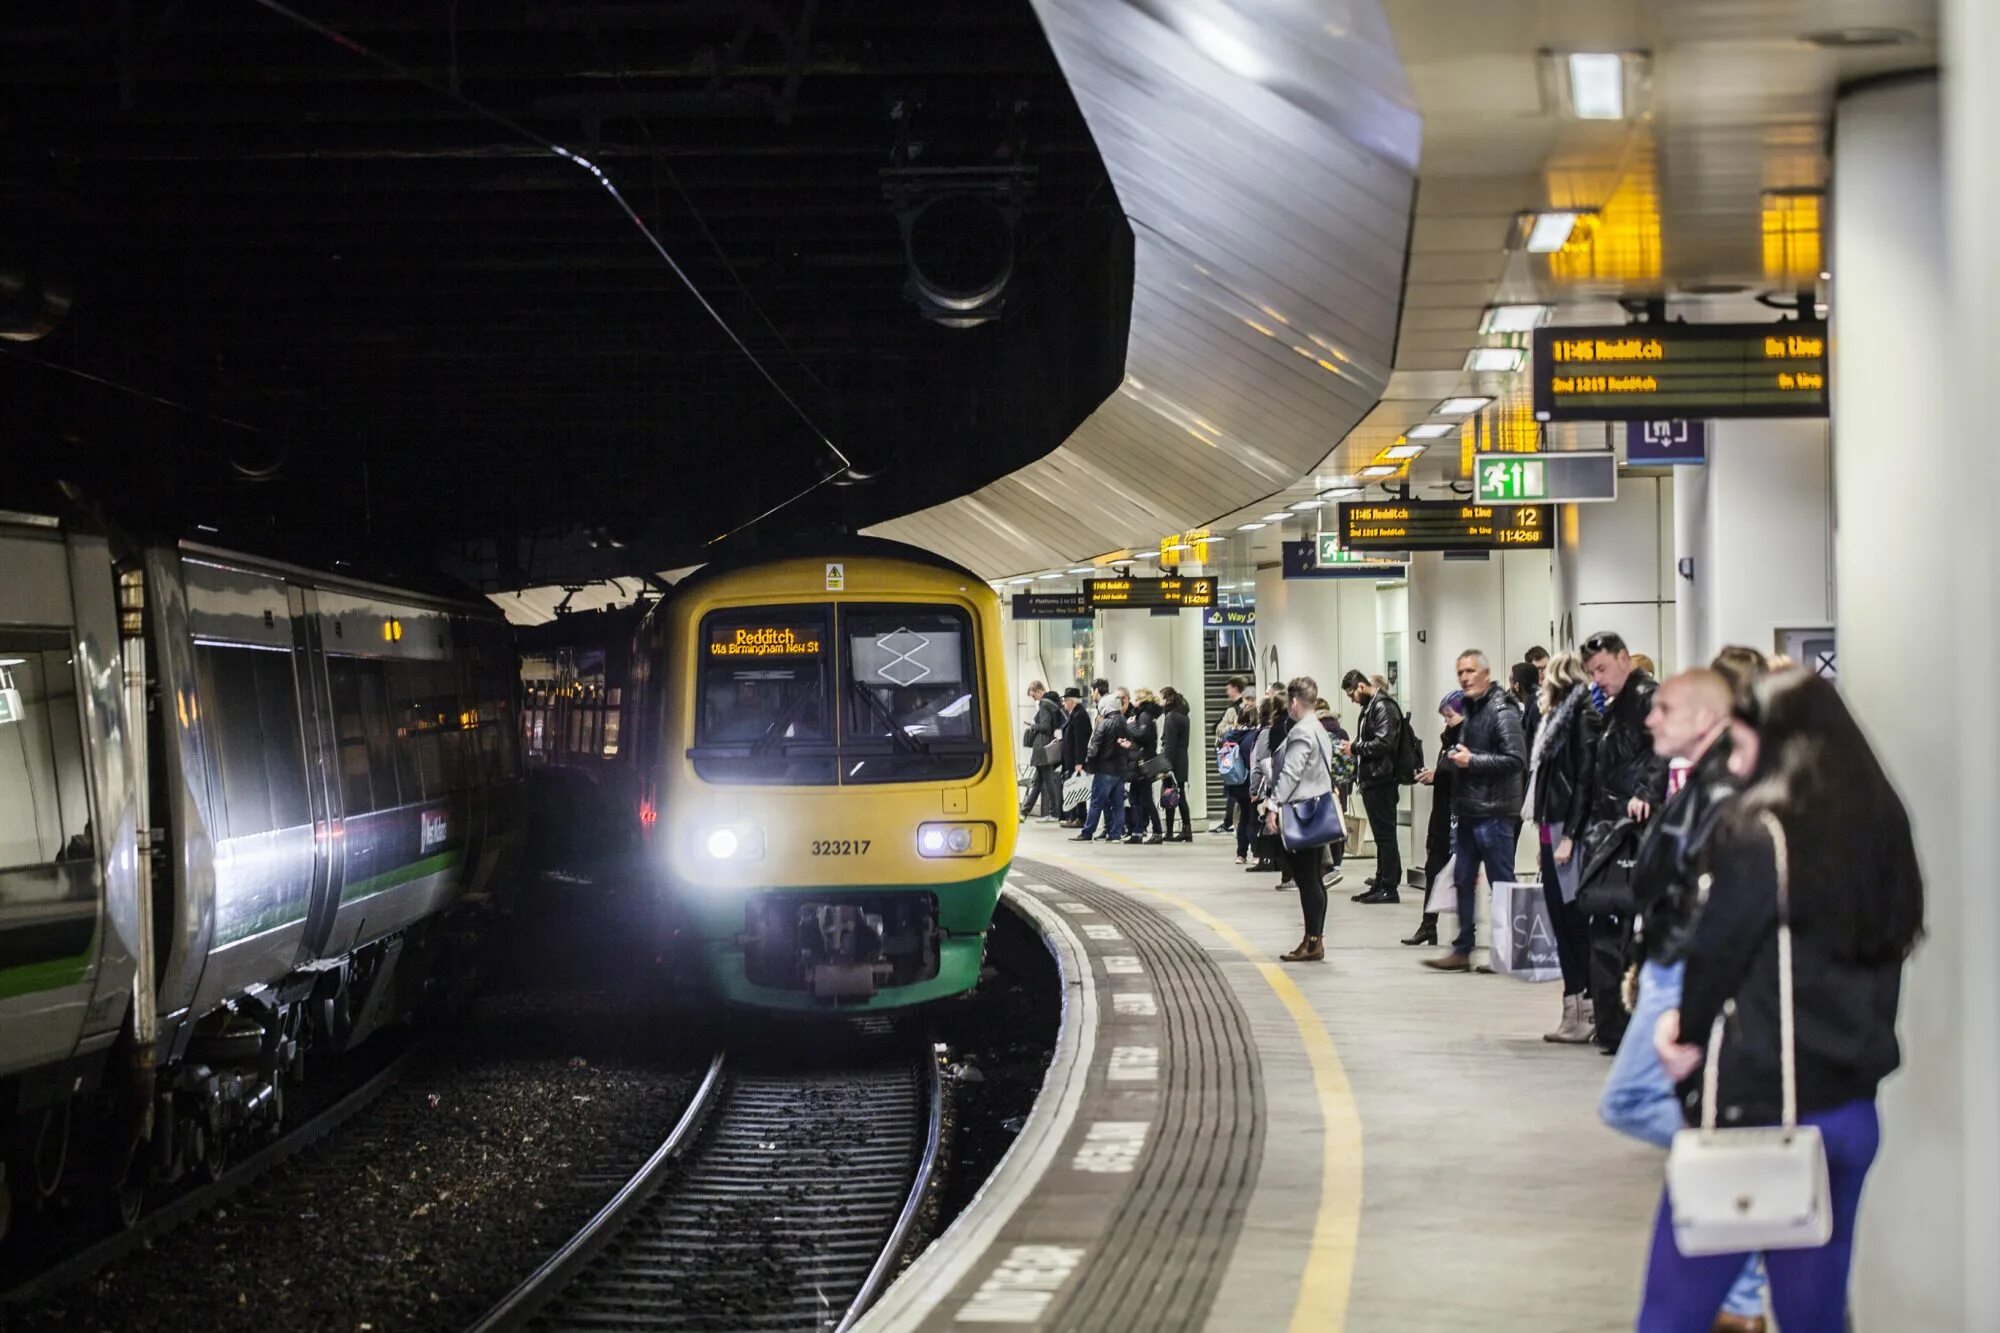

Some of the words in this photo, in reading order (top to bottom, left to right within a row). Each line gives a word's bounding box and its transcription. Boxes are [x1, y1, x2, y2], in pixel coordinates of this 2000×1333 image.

[1595, 338, 1662, 360] Redditch
[1372, 508, 1408, 520] Redditch
[1517, 508, 1537, 526] 12
[1194, 582, 1208, 594] 12
[1227, 612, 1246, 623] Way
[736, 628, 795, 644] Redditch
[711, 643, 727, 655] Via
[728, 642, 784, 656] Birmingham
[786, 642, 805, 653] New
[807, 641, 820, 653] St
[811, 840, 872, 856] 323217
